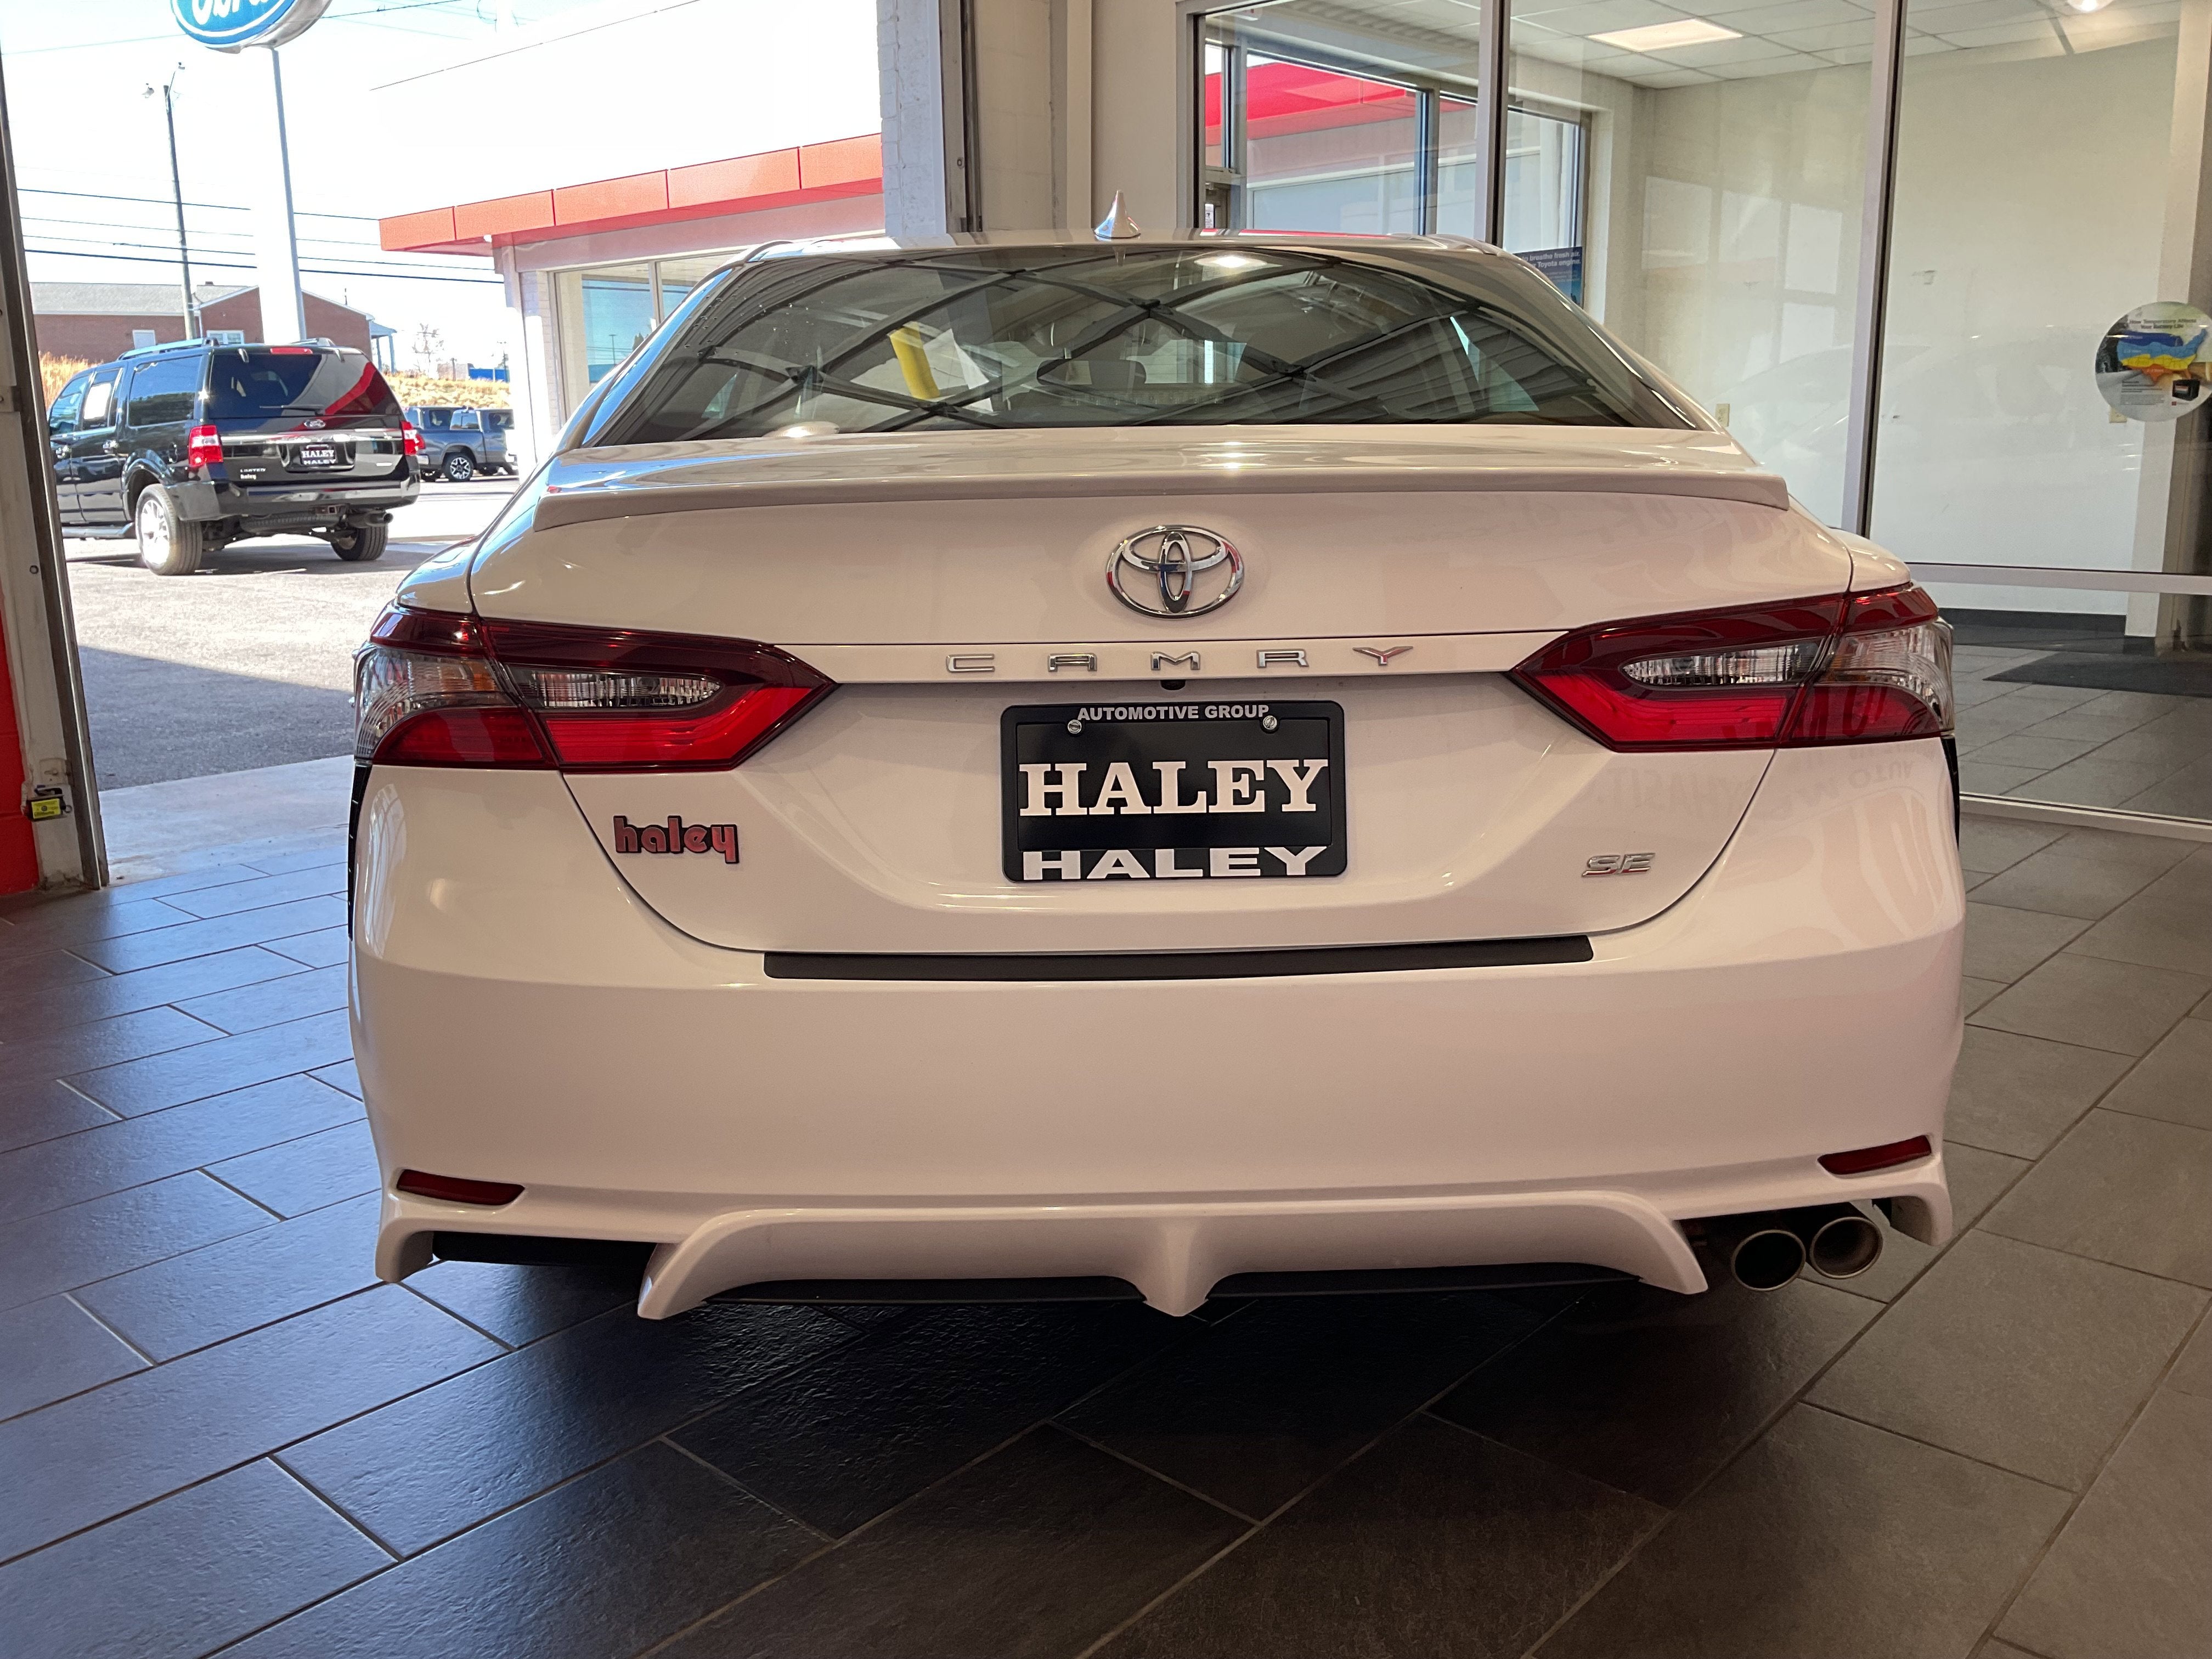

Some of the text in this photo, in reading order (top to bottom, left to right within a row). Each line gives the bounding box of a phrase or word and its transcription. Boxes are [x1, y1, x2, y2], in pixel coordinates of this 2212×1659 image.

[302, 450, 334, 458] HALEY
[946, 646, 1414, 673] CAMRY
[1077, 704, 1269, 721] AUTOMOTIVE GROUP
[1019, 759, 1329, 816] HALEY
[613, 815, 740, 864] haley
[1023, 846, 1328, 881] HALEY
[1582, 852, 1656, 877] SE
